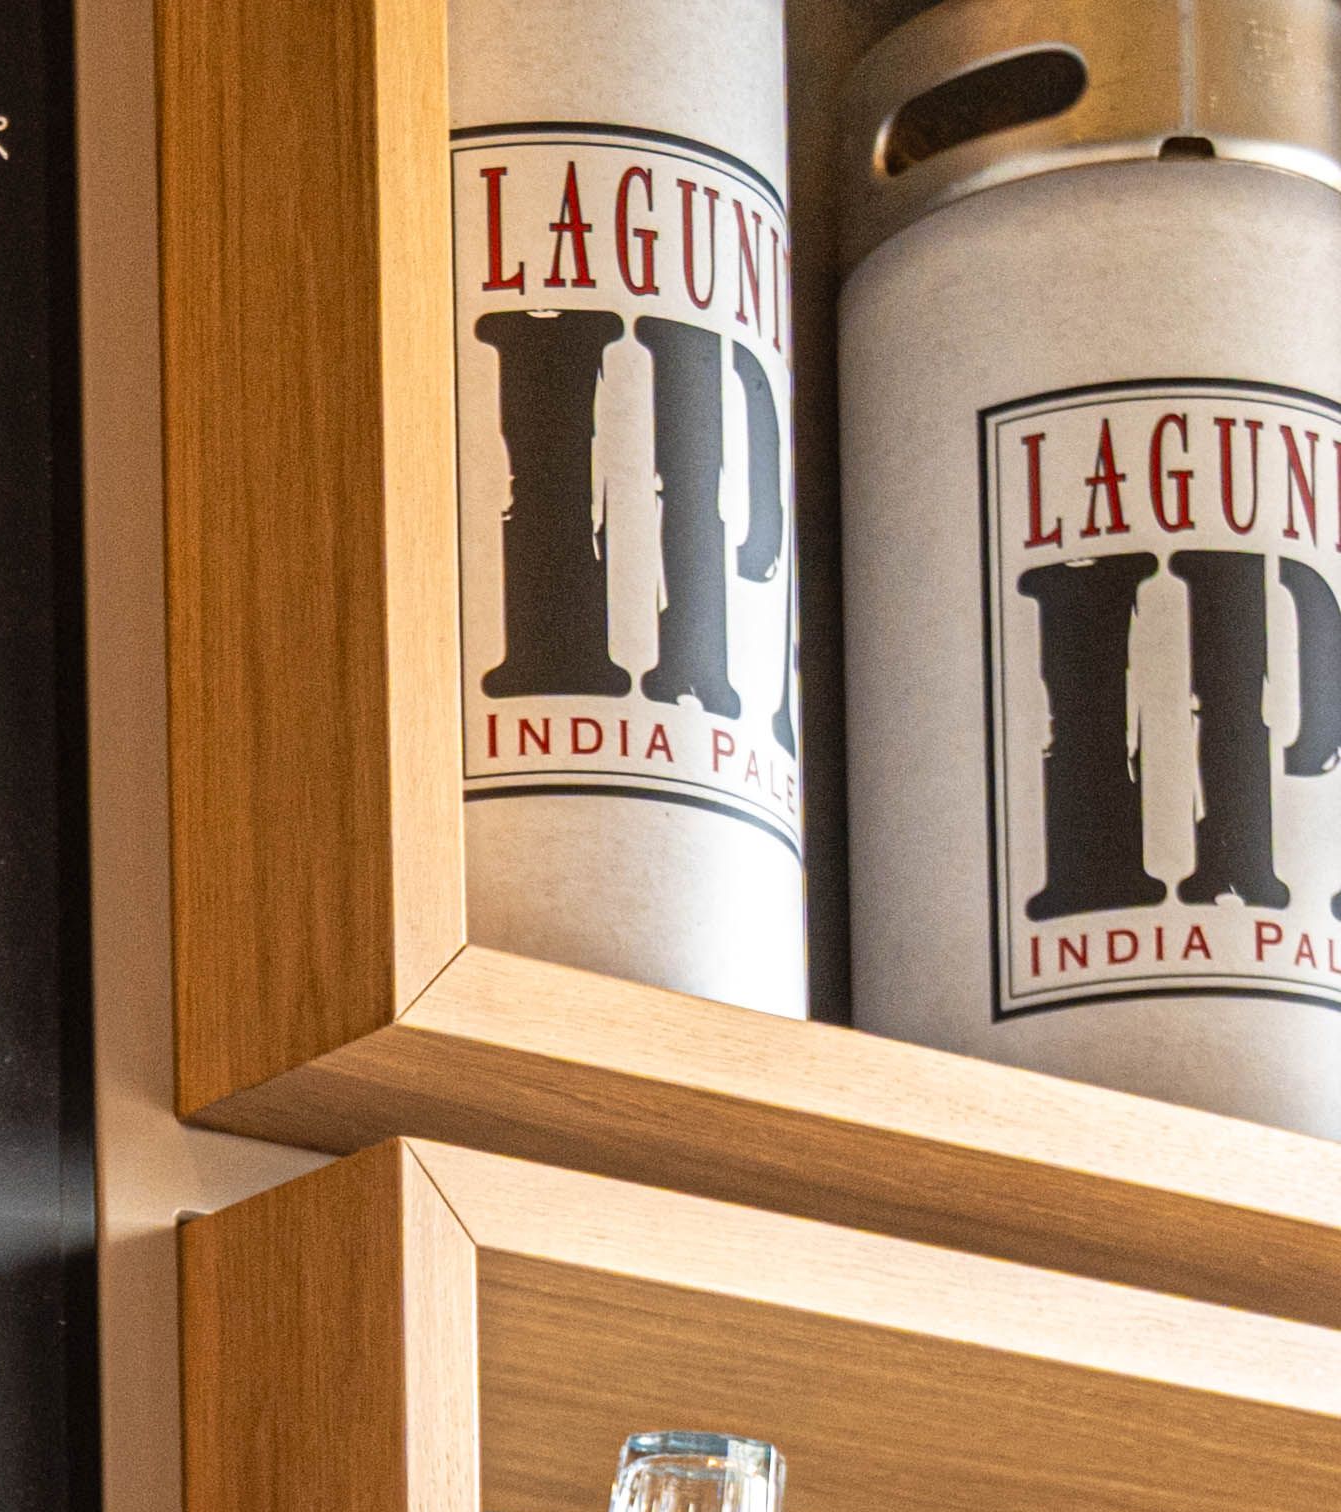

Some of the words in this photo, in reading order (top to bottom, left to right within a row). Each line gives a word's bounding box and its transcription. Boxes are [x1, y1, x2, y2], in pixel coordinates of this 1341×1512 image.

[480, 160, 791, 372] LAGUNI
[472, 308, 797, 762] IP
[484, 711, 676, 763] INDIA
[1016, 551, 1341, 922] IP
[1029, 924, 1214, 979] INDIA
[1254, 920, 1341, 976] PAL
